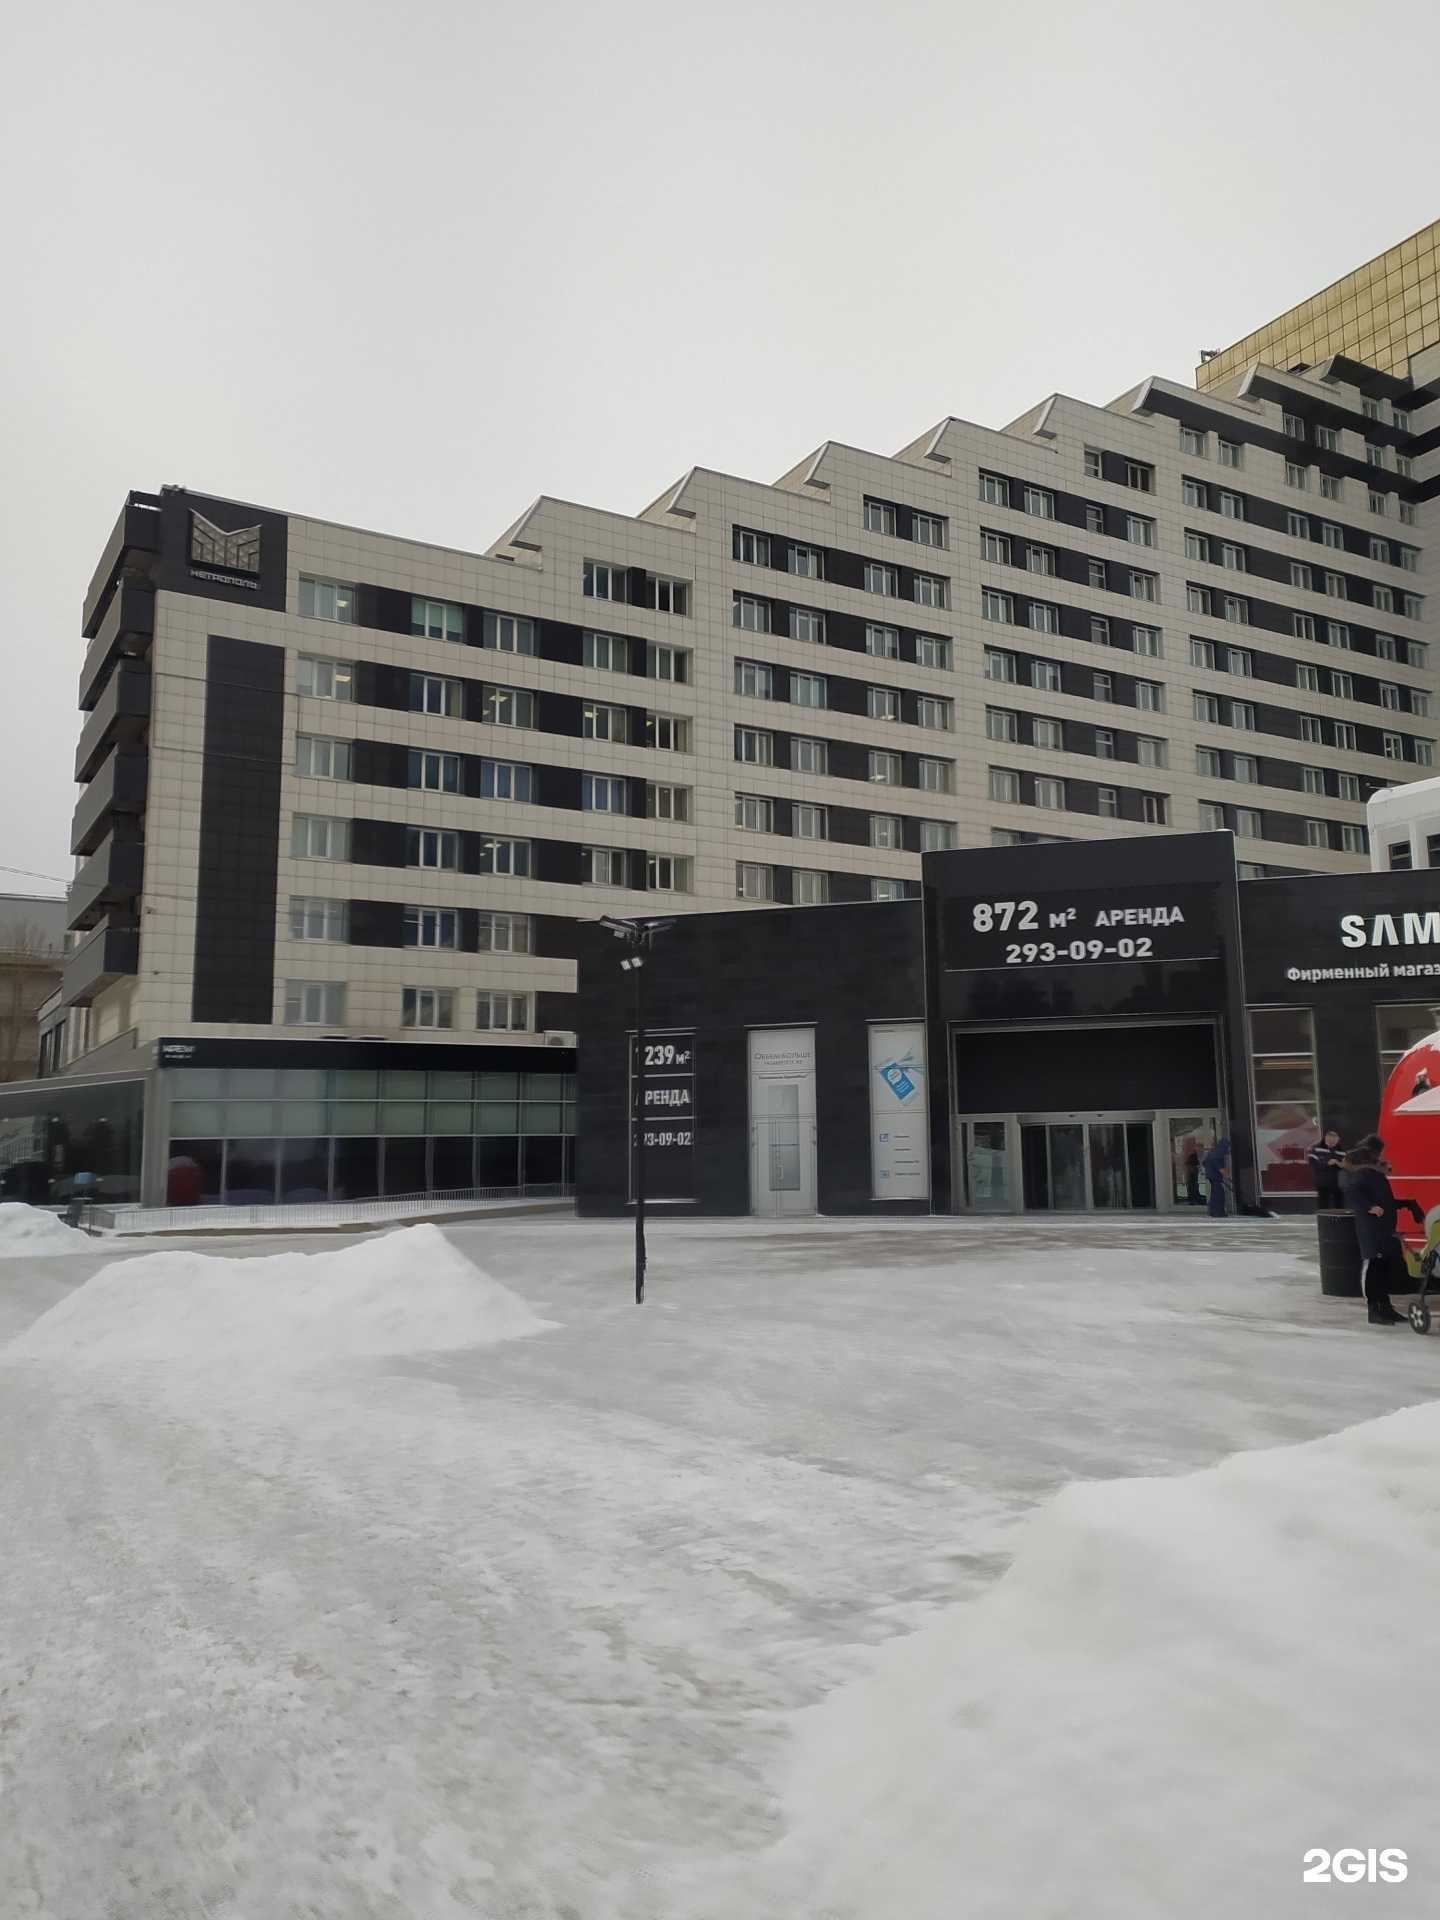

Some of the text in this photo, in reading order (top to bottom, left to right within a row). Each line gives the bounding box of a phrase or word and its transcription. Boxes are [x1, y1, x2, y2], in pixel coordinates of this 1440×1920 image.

[972, 900, 1039, 933] 872
[1095, 906, 1185, 927] АРЕНДА
[1005, 937, 1153, 964] 293-09-02
[1287, 963, 1390, 982] Фирменный
[635, 1089, 690, 1107] РЕНДА
